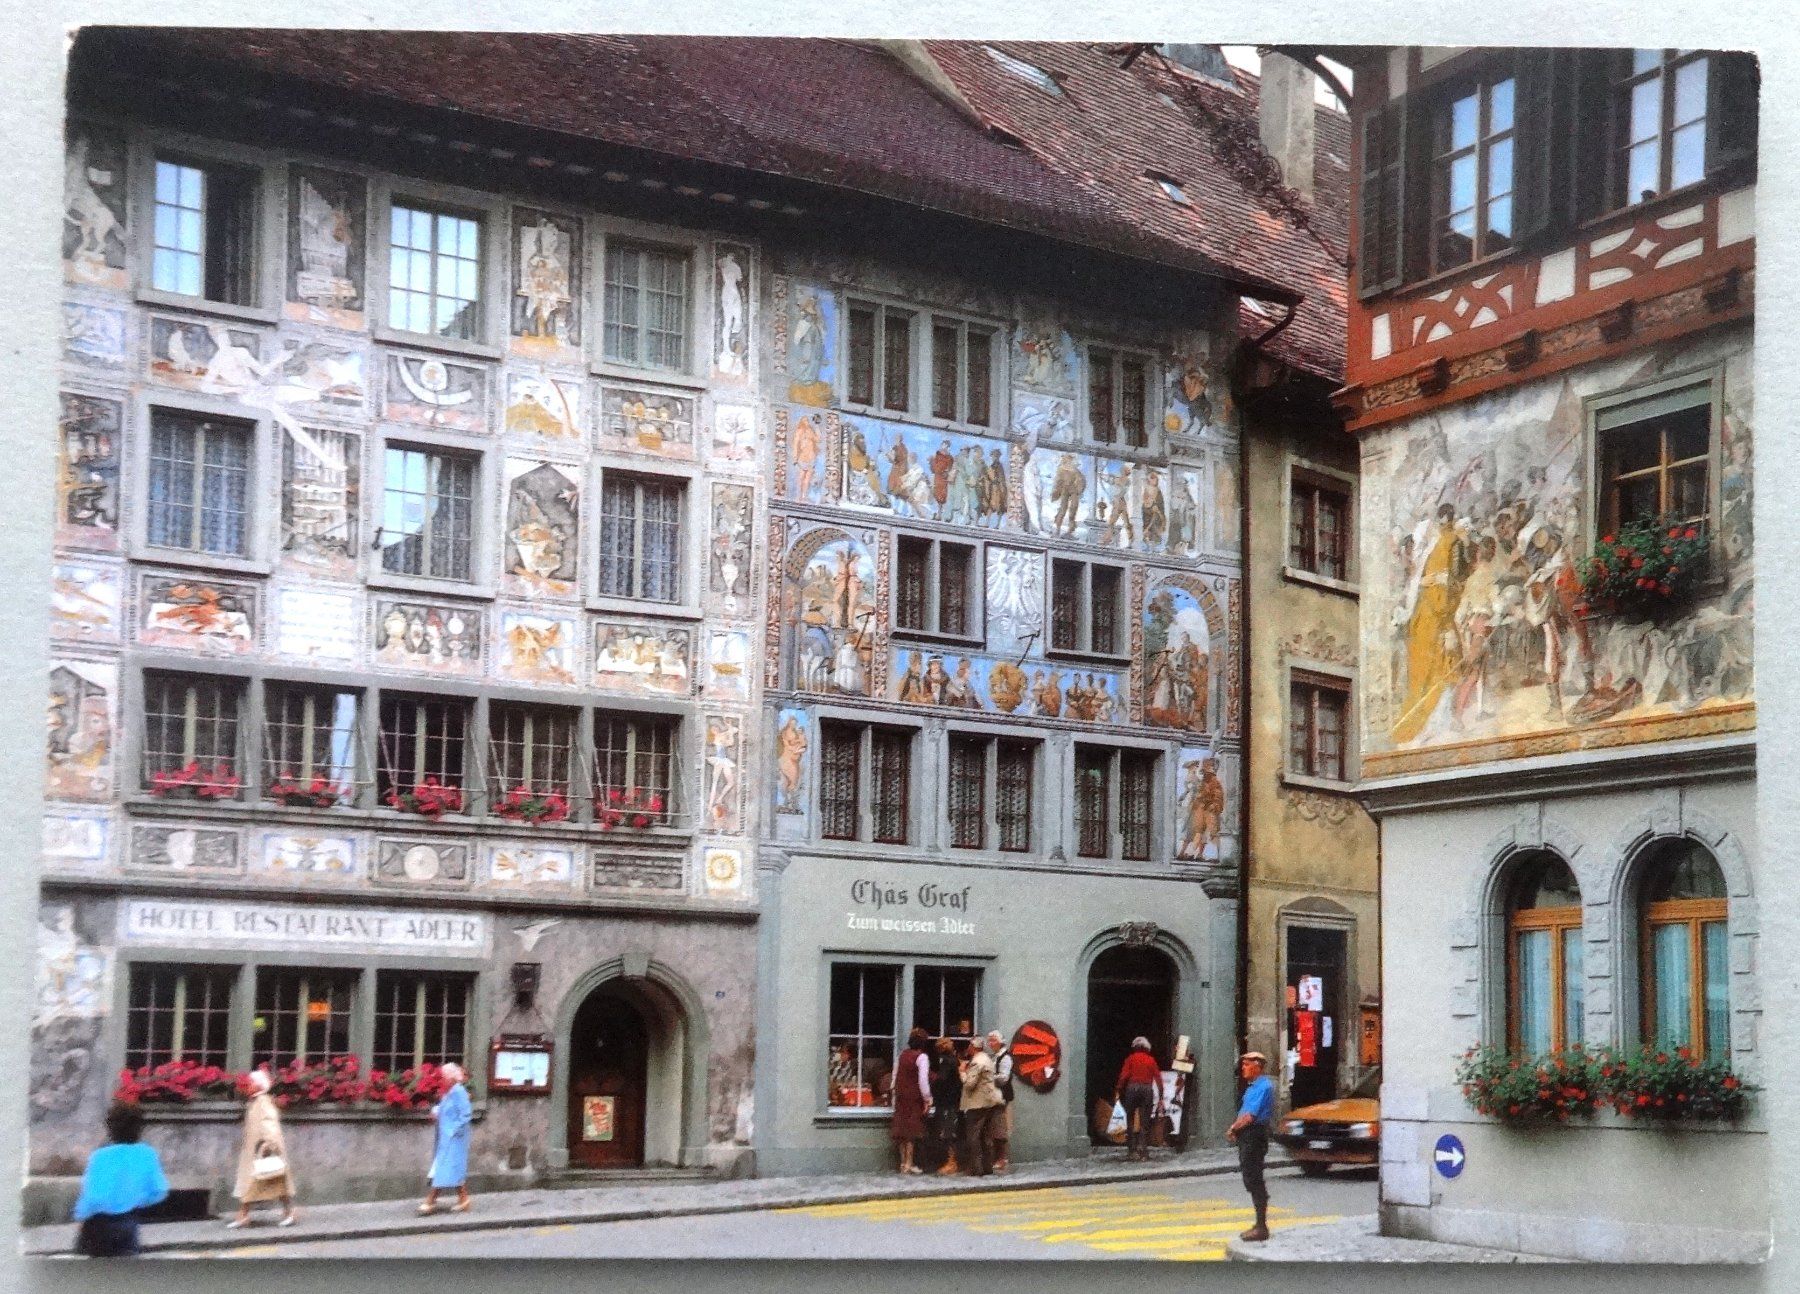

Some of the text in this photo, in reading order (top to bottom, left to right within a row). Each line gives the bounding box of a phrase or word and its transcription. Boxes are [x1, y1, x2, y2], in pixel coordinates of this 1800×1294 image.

[851, 879, 971, 913] Chäs Graf
[138, 907, 476, 941] HOTEL RESTAURANT ADLER
[846, 911, 975, 935] Zum weissen Adler
